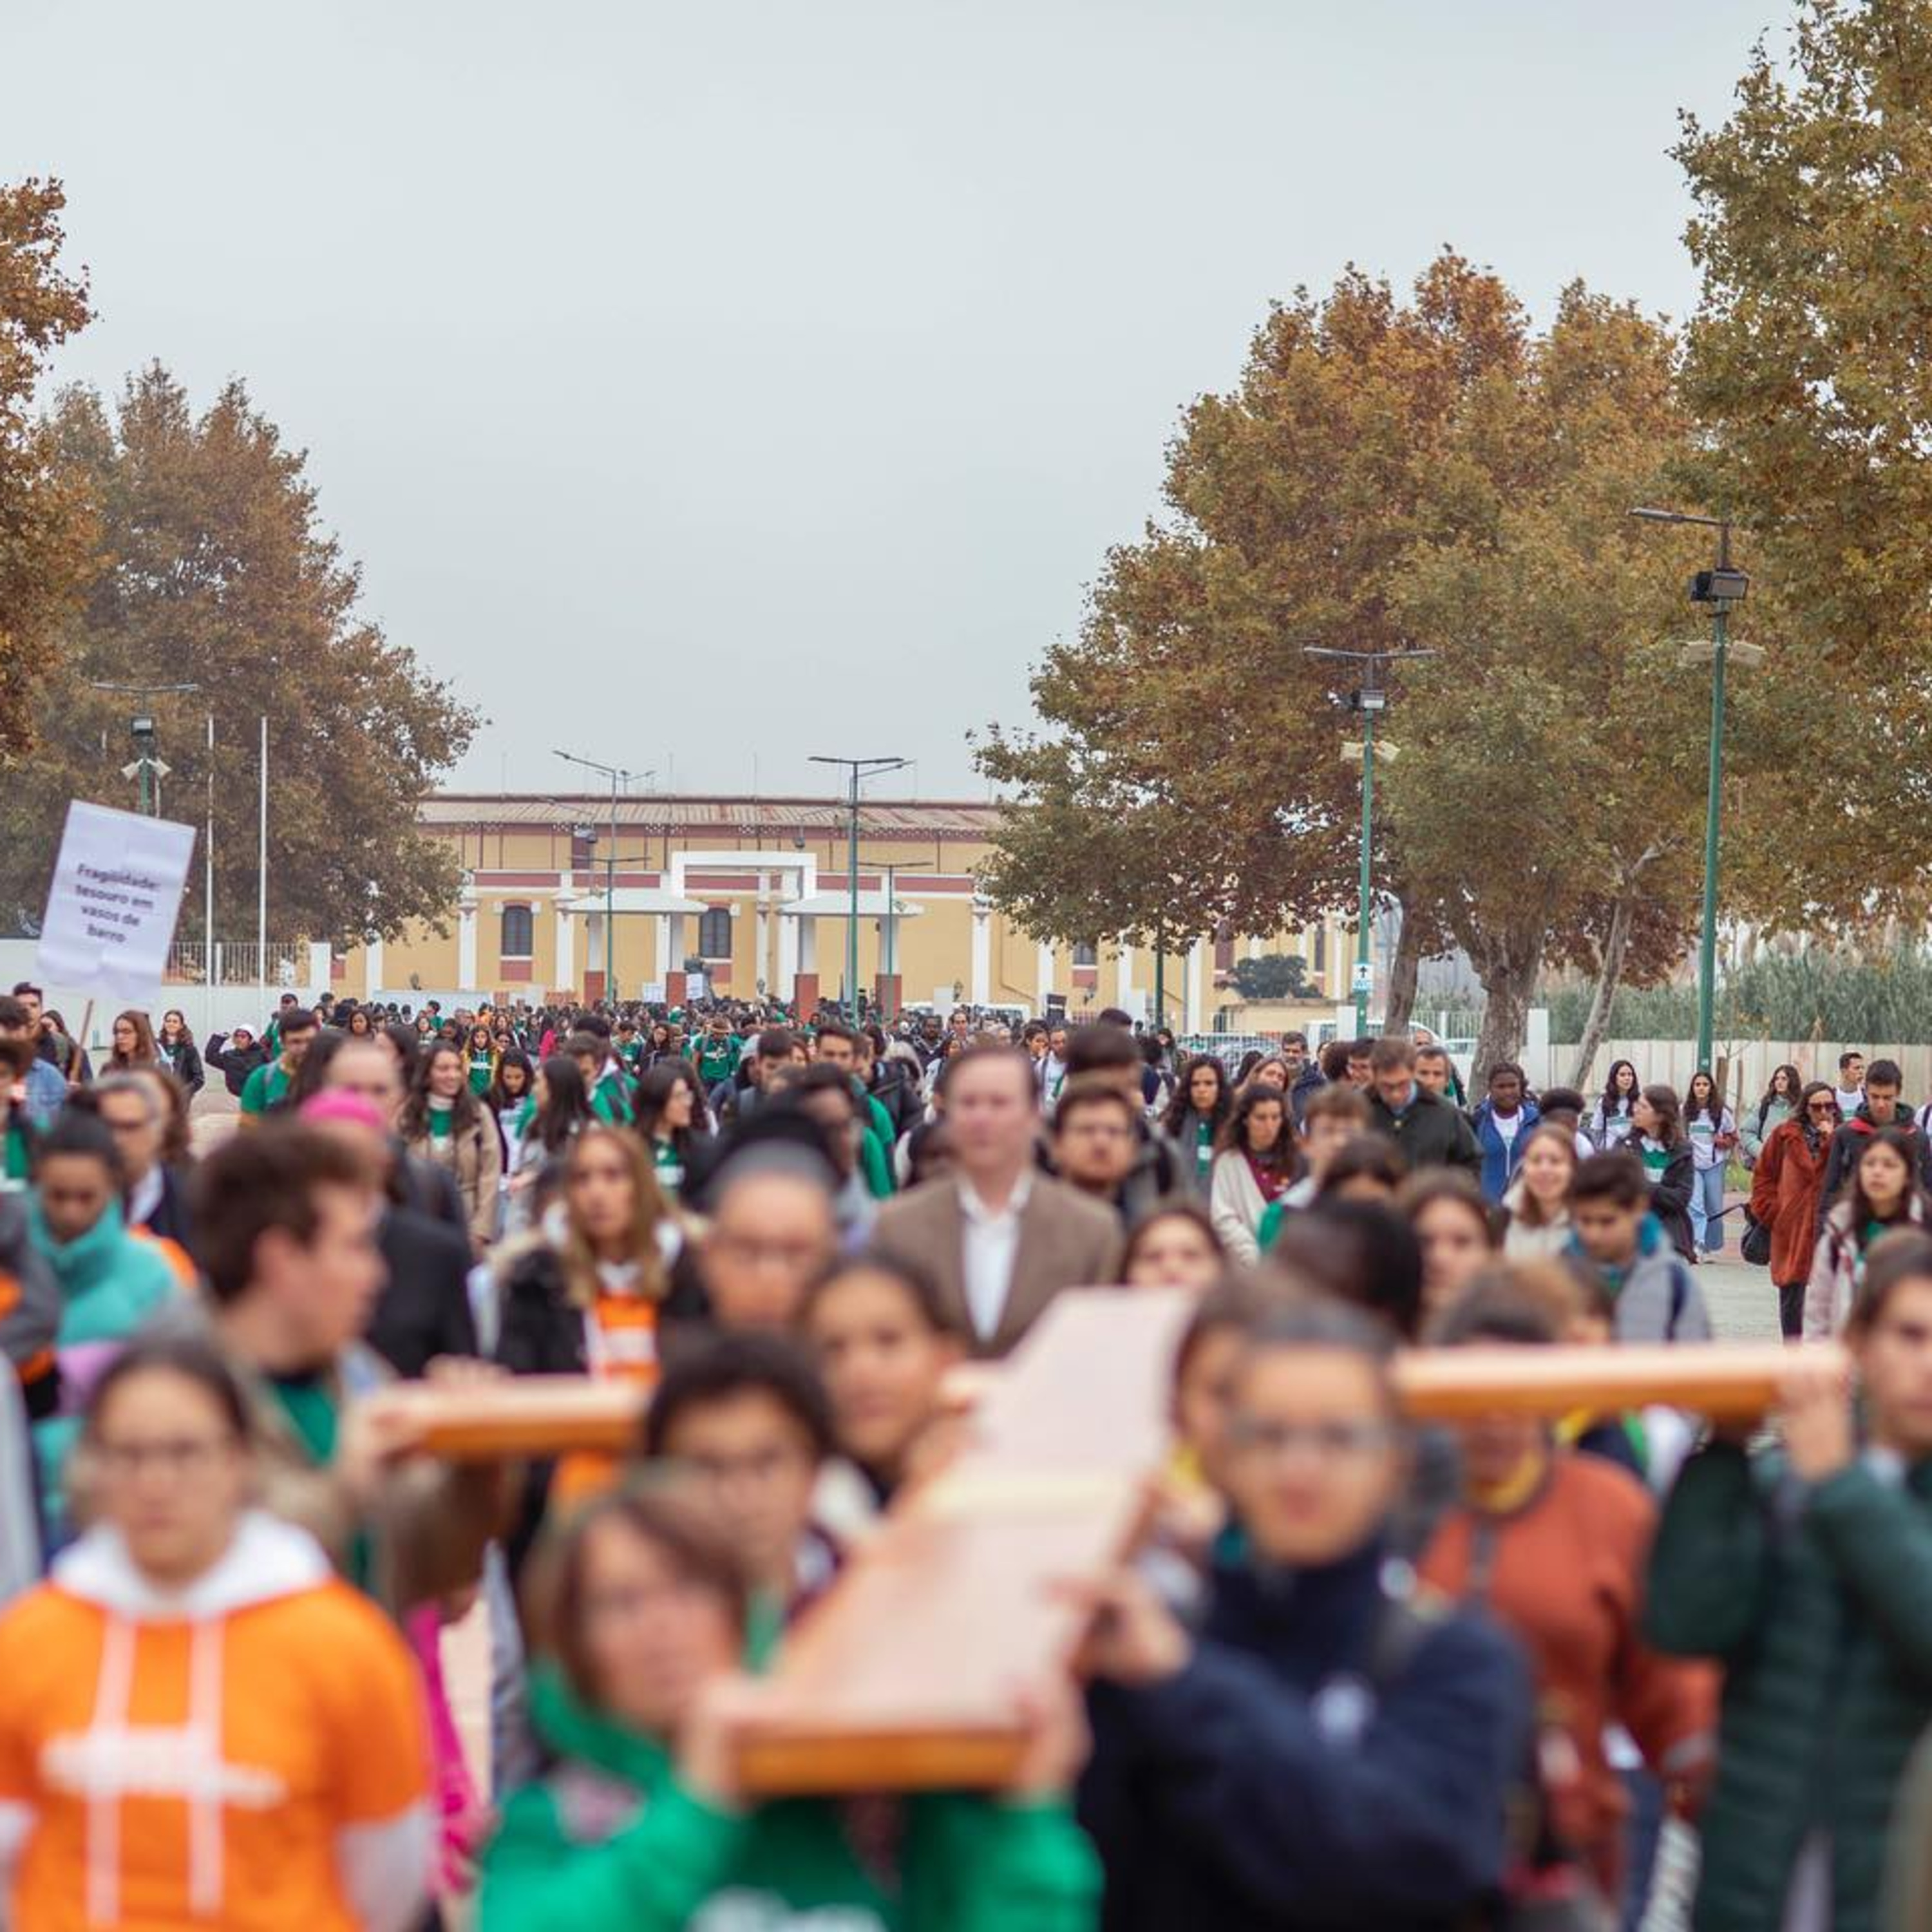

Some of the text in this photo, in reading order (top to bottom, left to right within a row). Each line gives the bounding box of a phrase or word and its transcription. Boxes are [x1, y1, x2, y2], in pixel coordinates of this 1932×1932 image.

[75, 885, 153, 909] tesouro em
[80, 905, 139, 926] vasos de
[88, 924, 126, 942] barro
